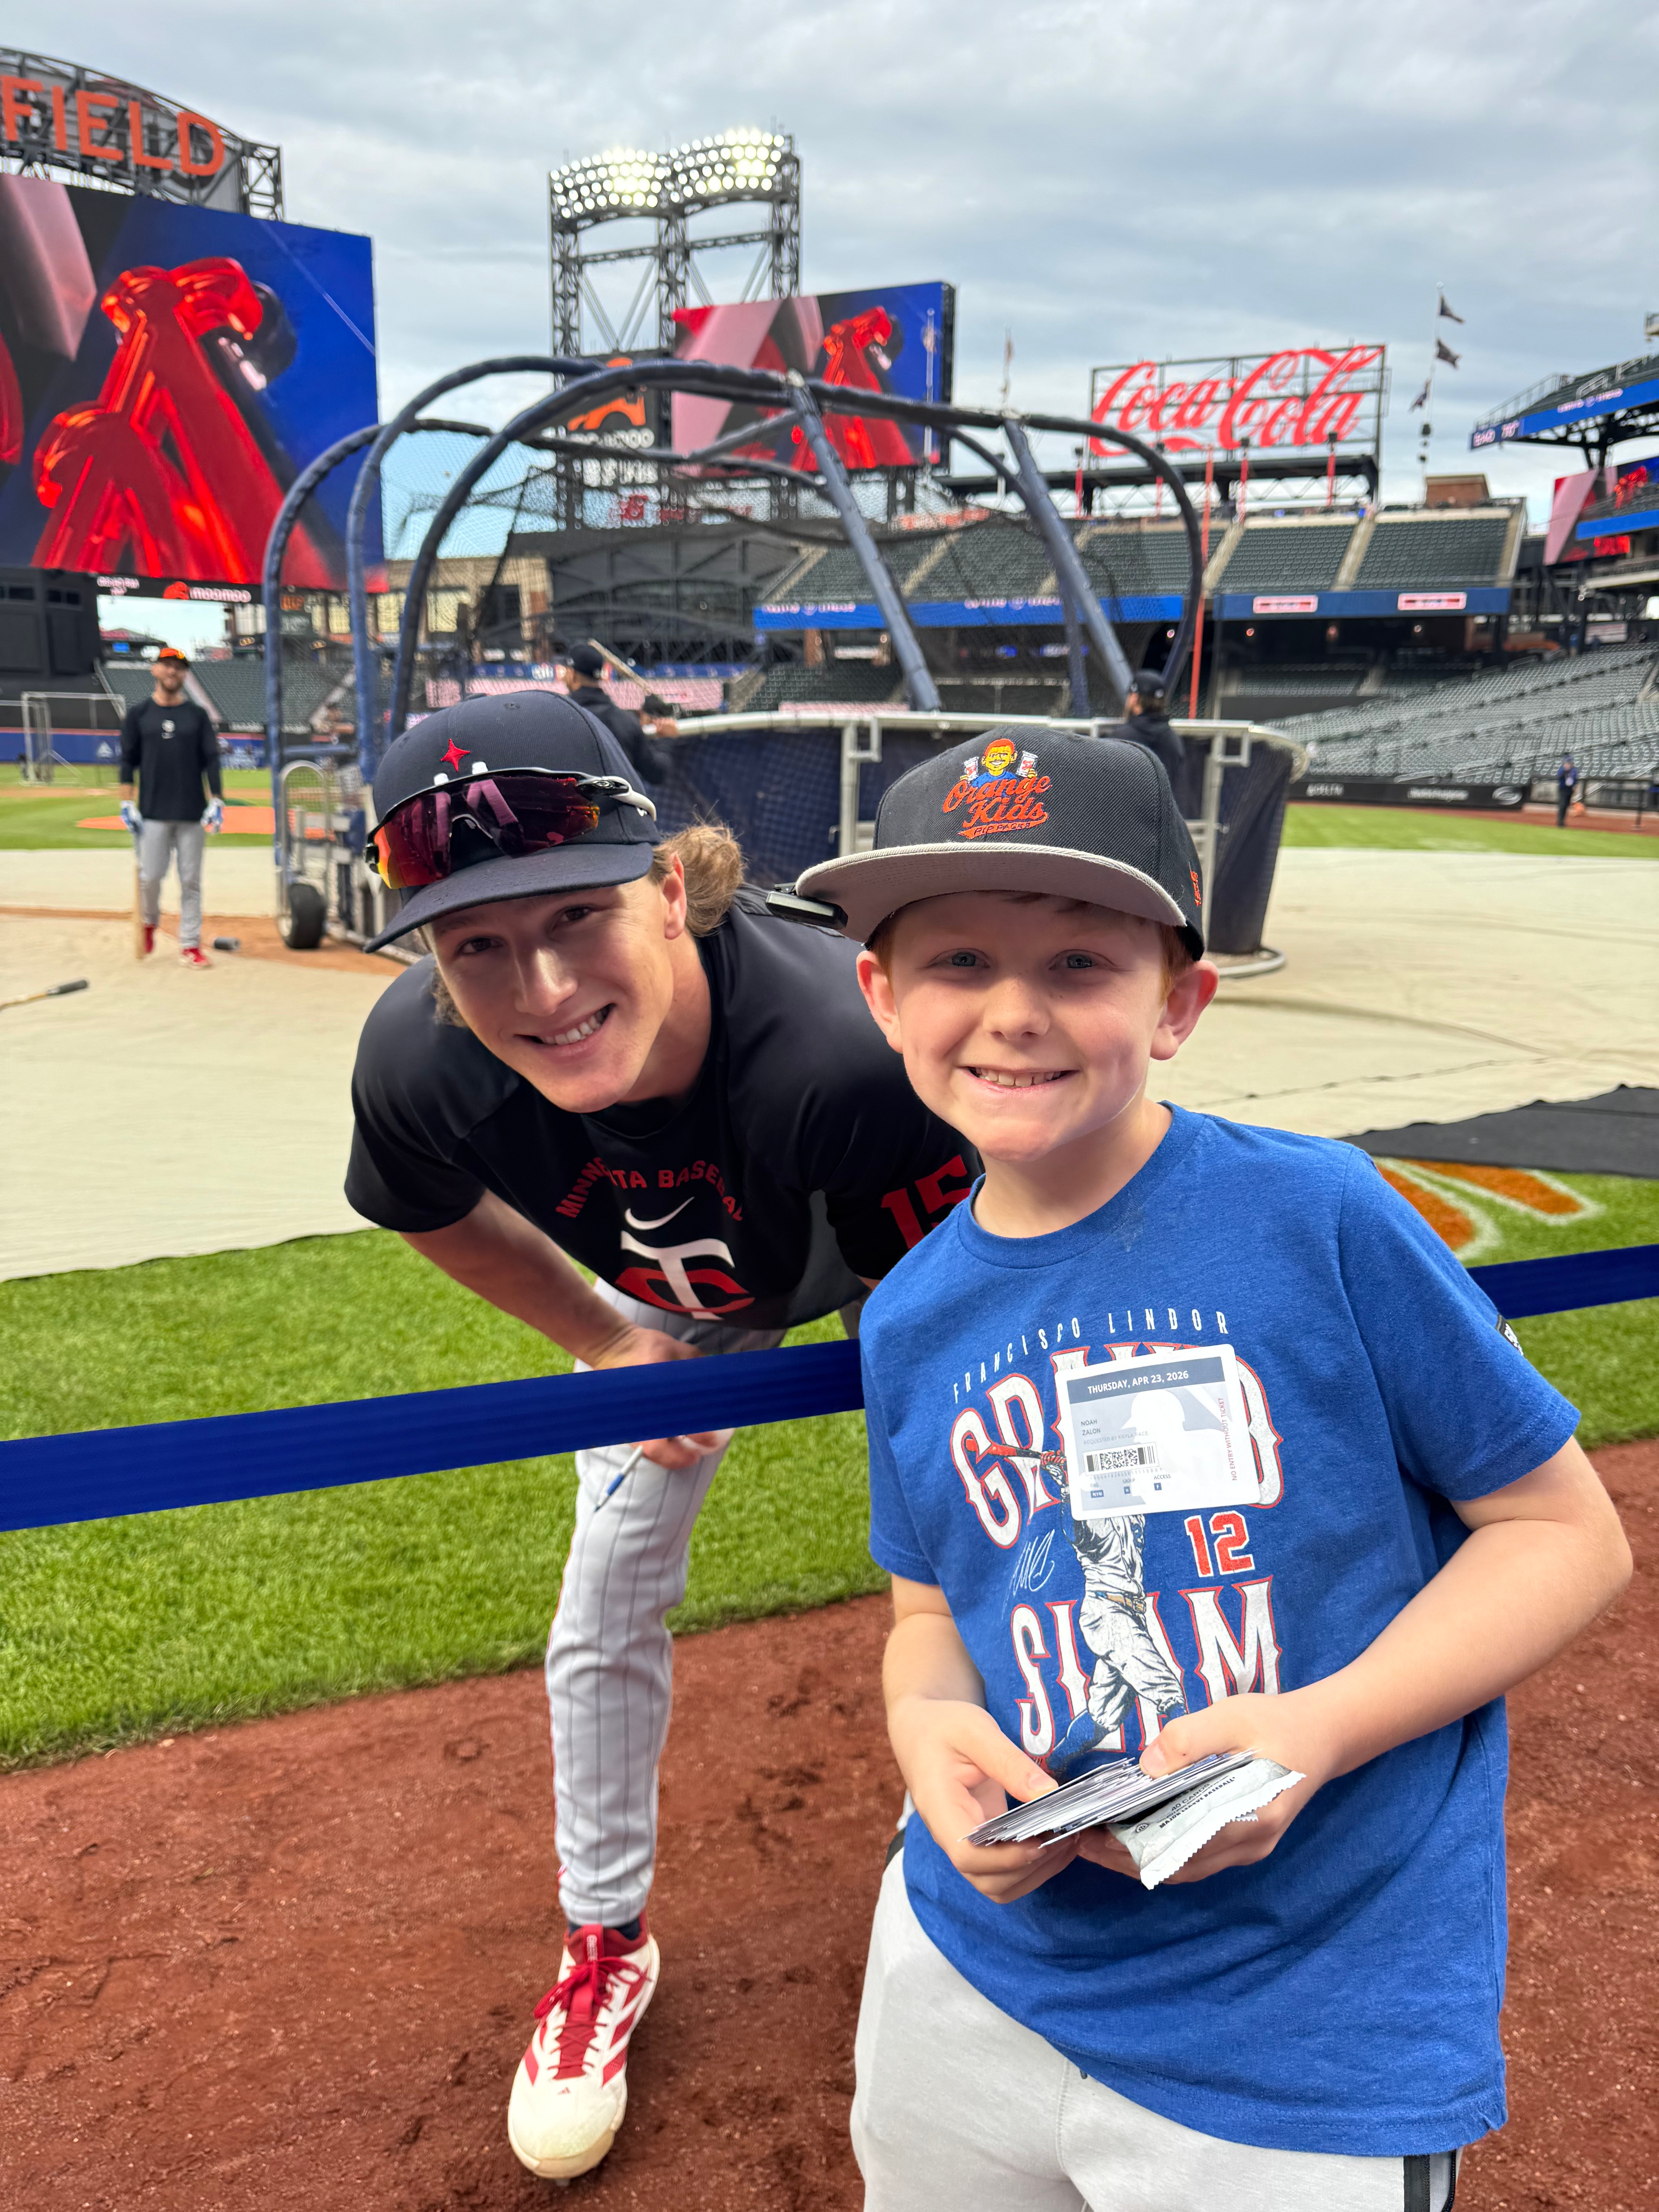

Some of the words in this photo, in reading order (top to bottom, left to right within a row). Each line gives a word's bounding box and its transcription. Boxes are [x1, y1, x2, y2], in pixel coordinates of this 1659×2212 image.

[1, 76, 226, 176] FIELD
[1089, 345, 1385, 457] Coca-Cola
[942, 775, 1053, 813] Orange
[962, 797, 1045, 828] Kids
[556, 1157, 647, 1218] MINNETA
[881, 1154, 972, 1250] 15
[953, 1317, 1080, 1404] FRANCISCO
[1108, 1308, 1229, 1334] LINDOR
[1087, 1379, 1130, 1394] THURSDAY,
[1132, 1376, 1149, 1386] APR
[1151, 1374, 1164, 1383] 23,
[1166, 1370, 1189, 1381] 2026
[1218, 1397, 1226, 1417] TICKET
[950, 1341, 1284, 1549] GRD
[1222, 1419, 1232, 1448] WITHOUT
[1227, 1449, 1235, 1469] ENTRY
[1231, 1471, 1237, 1481] NO
[1184, 1510, 1255, 1578] 12
[1159, 1812, 1182, 1828] MAJOR
[1182, 1797, 1204, 1812] LEAGUE
